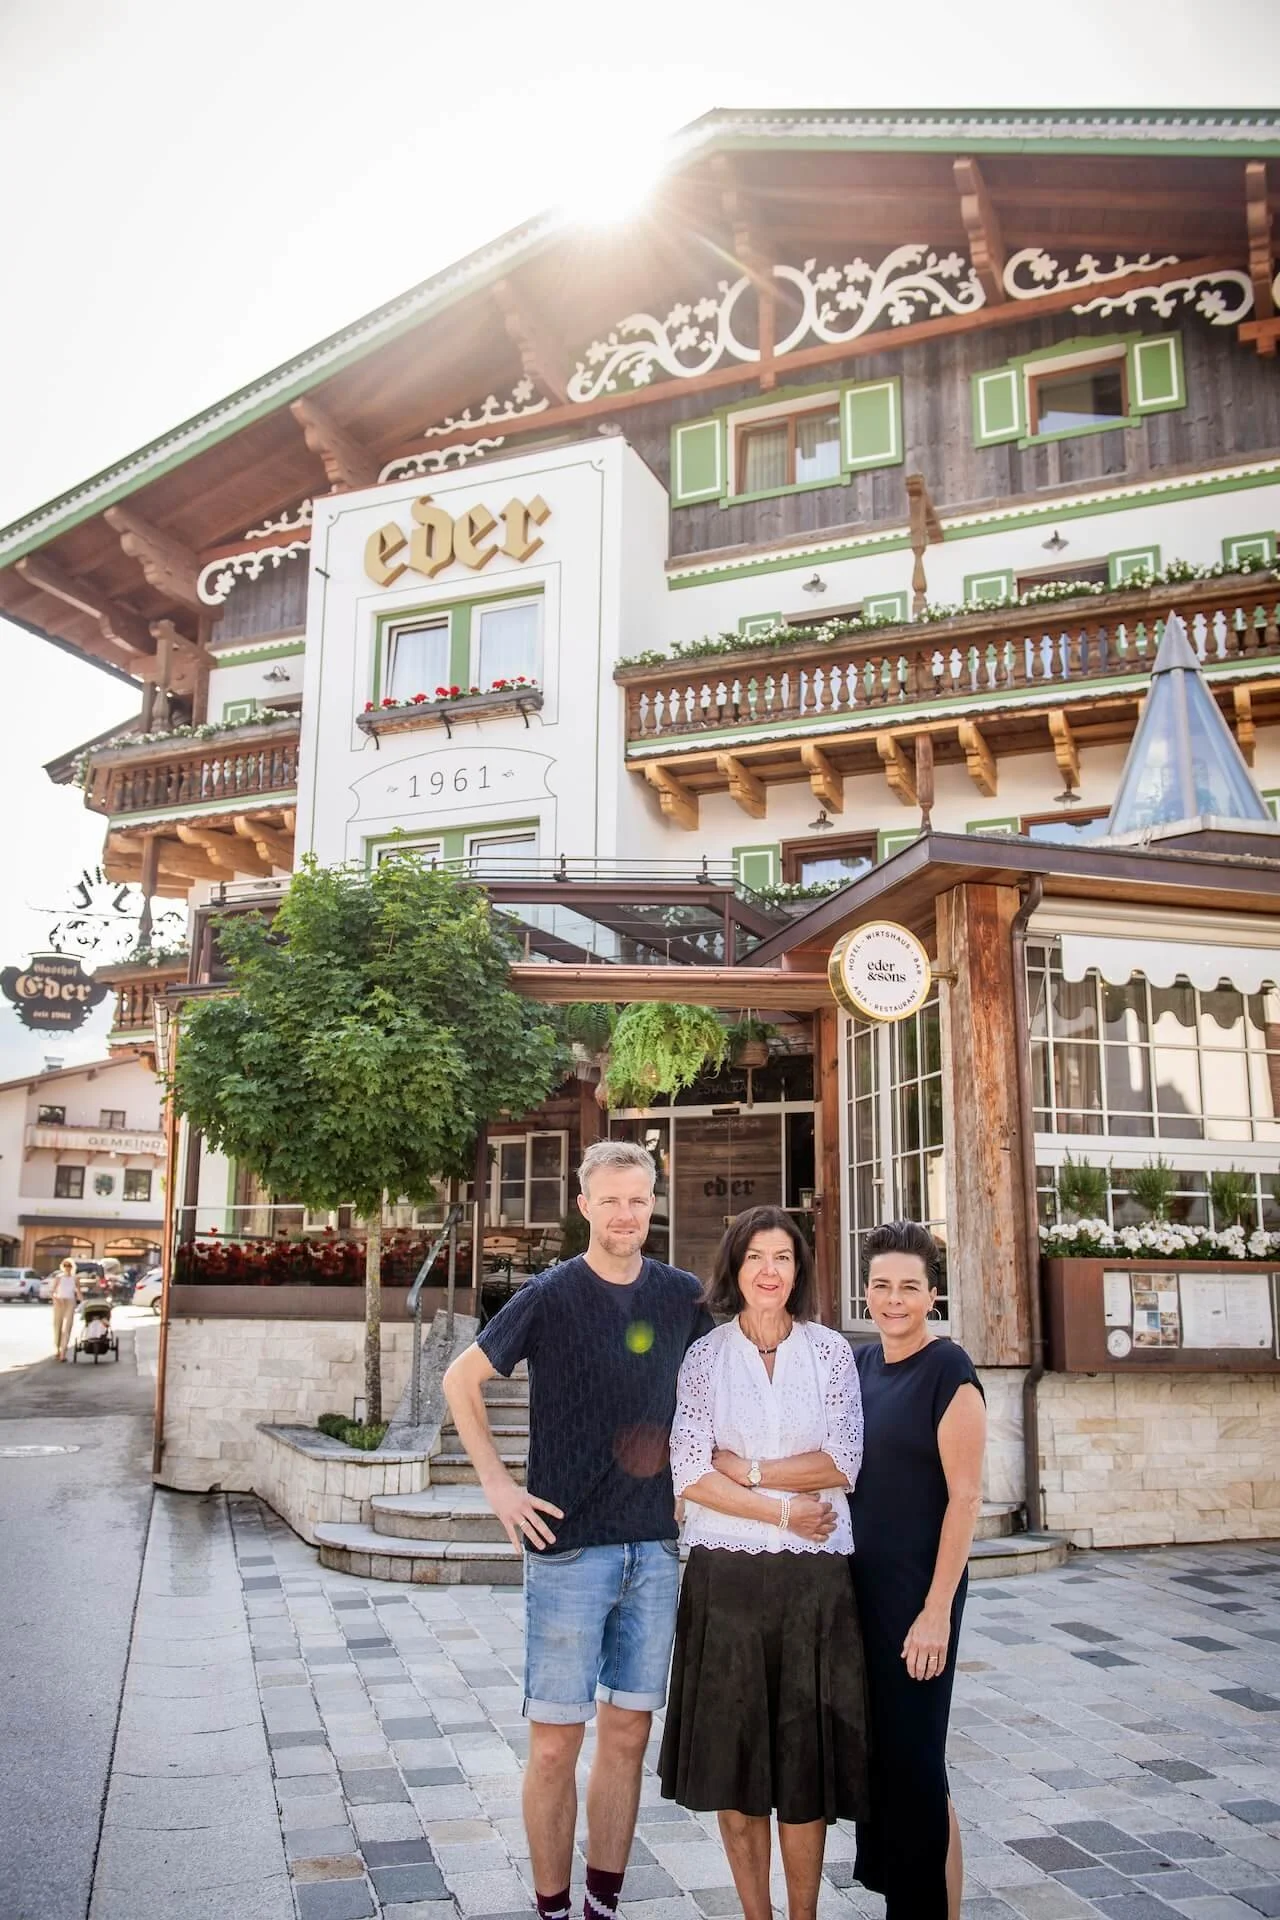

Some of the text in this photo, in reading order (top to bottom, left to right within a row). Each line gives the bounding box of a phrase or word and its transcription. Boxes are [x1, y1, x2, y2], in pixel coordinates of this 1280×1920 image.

[363, 495, 552, 588] eder
[408, 765, 491, 798] 1961
[848, 930, 922, 975] HOTEL WIRTSHAUS BAR
[867, 959, 896, 972] eder
[15, 975, 92, 1002] Eder
[866, 971, 907, 983] &sons
[853, 985, 919, 1013] ASIA RESTAURANT
[88, 1136, 166, 1149] GEMEIND
[703, 1176, 756, 1197] eder
